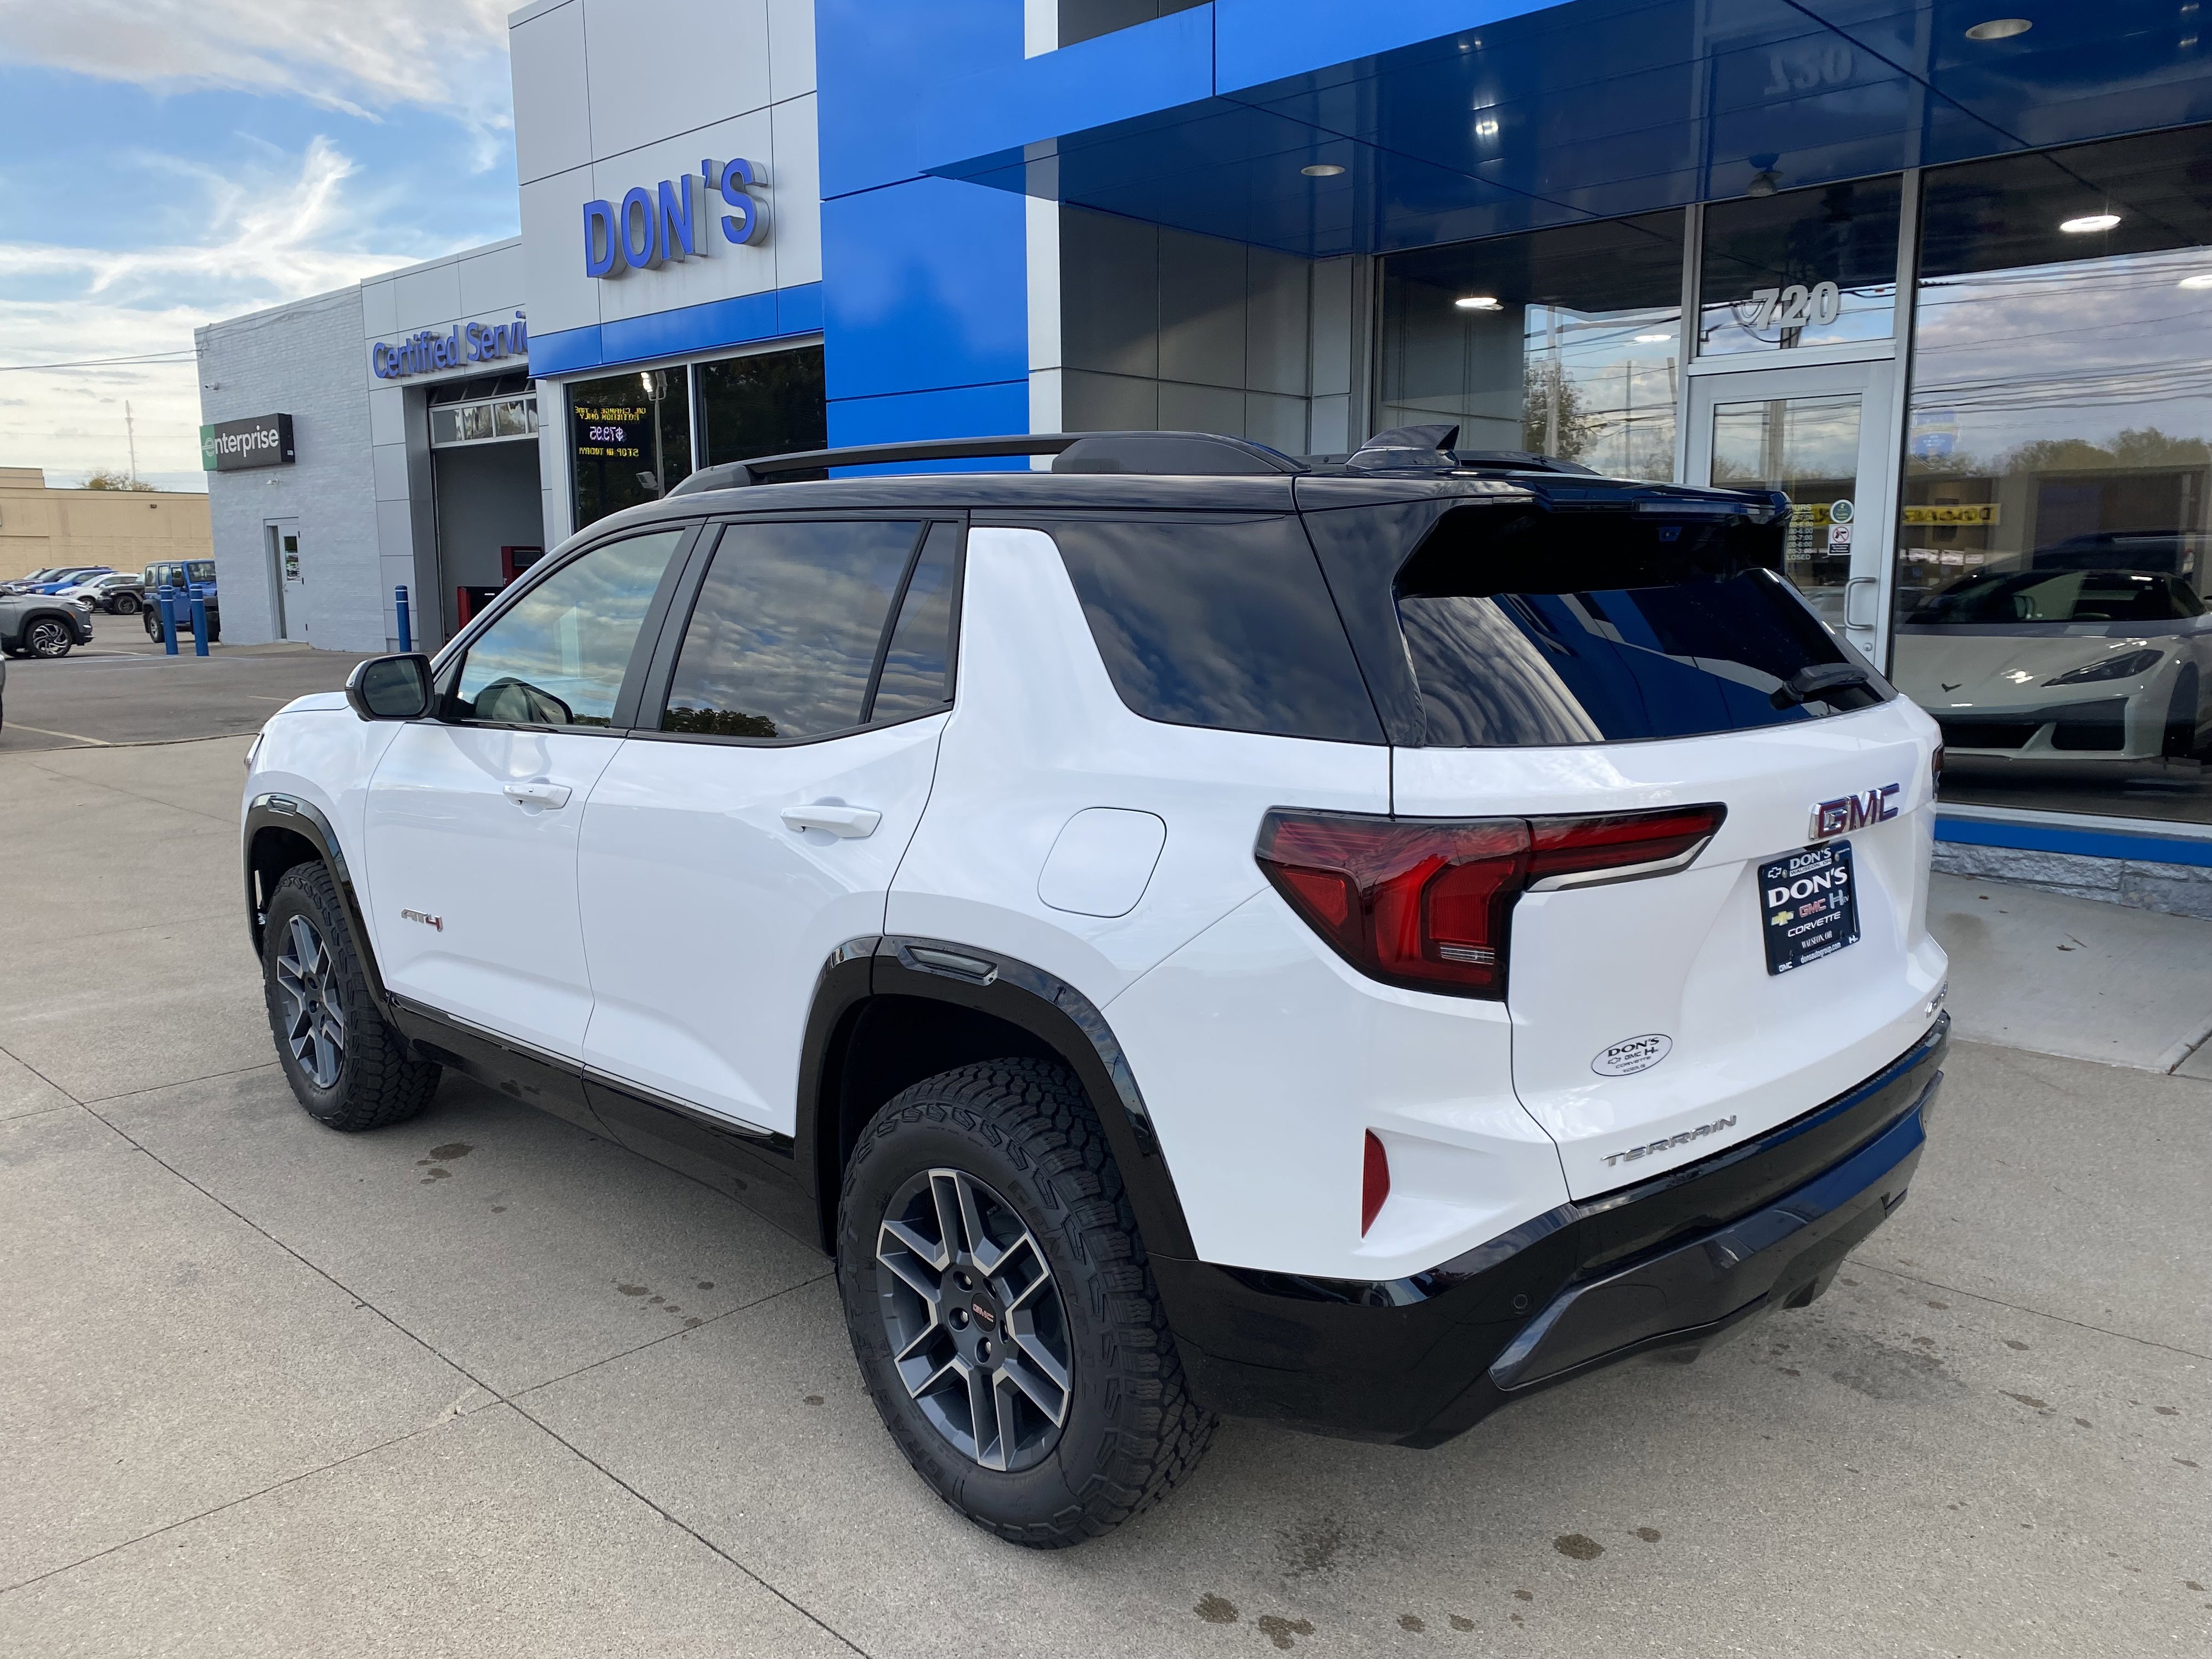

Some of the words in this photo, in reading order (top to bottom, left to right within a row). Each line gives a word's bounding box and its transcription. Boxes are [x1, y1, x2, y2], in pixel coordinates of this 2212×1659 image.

[583, 157, 770, 279] DON'S
[1752, 281, 1839, 331] 720
[373, 325, 461, 379] Certified
[201, 425, 279, 458] enterprise
[1809, 782, 1900, 839] GMC
[1790, 847, 1832, 870] DON'S
[1768, 866, 1848, 908] DON'S
[401, 908, 443, 932] AT4
[1799, 898, 1827, 918] GMC
[1787, 911, 1841, 938] CORVETTE
[1801, 942, 1841, 963] donsautogroup.com
[1779, 961, 1793, 972] GMC
[1607, 1037, 1660, 1057] DON'S
[1624, 1051, 1641, 1060] GMC
[1615, 1056, 1651, 1069] CORVETTE
[1600, 1114, 1737, 1167] TERRAIN
[973, 1303, 994, 1322] GMC
